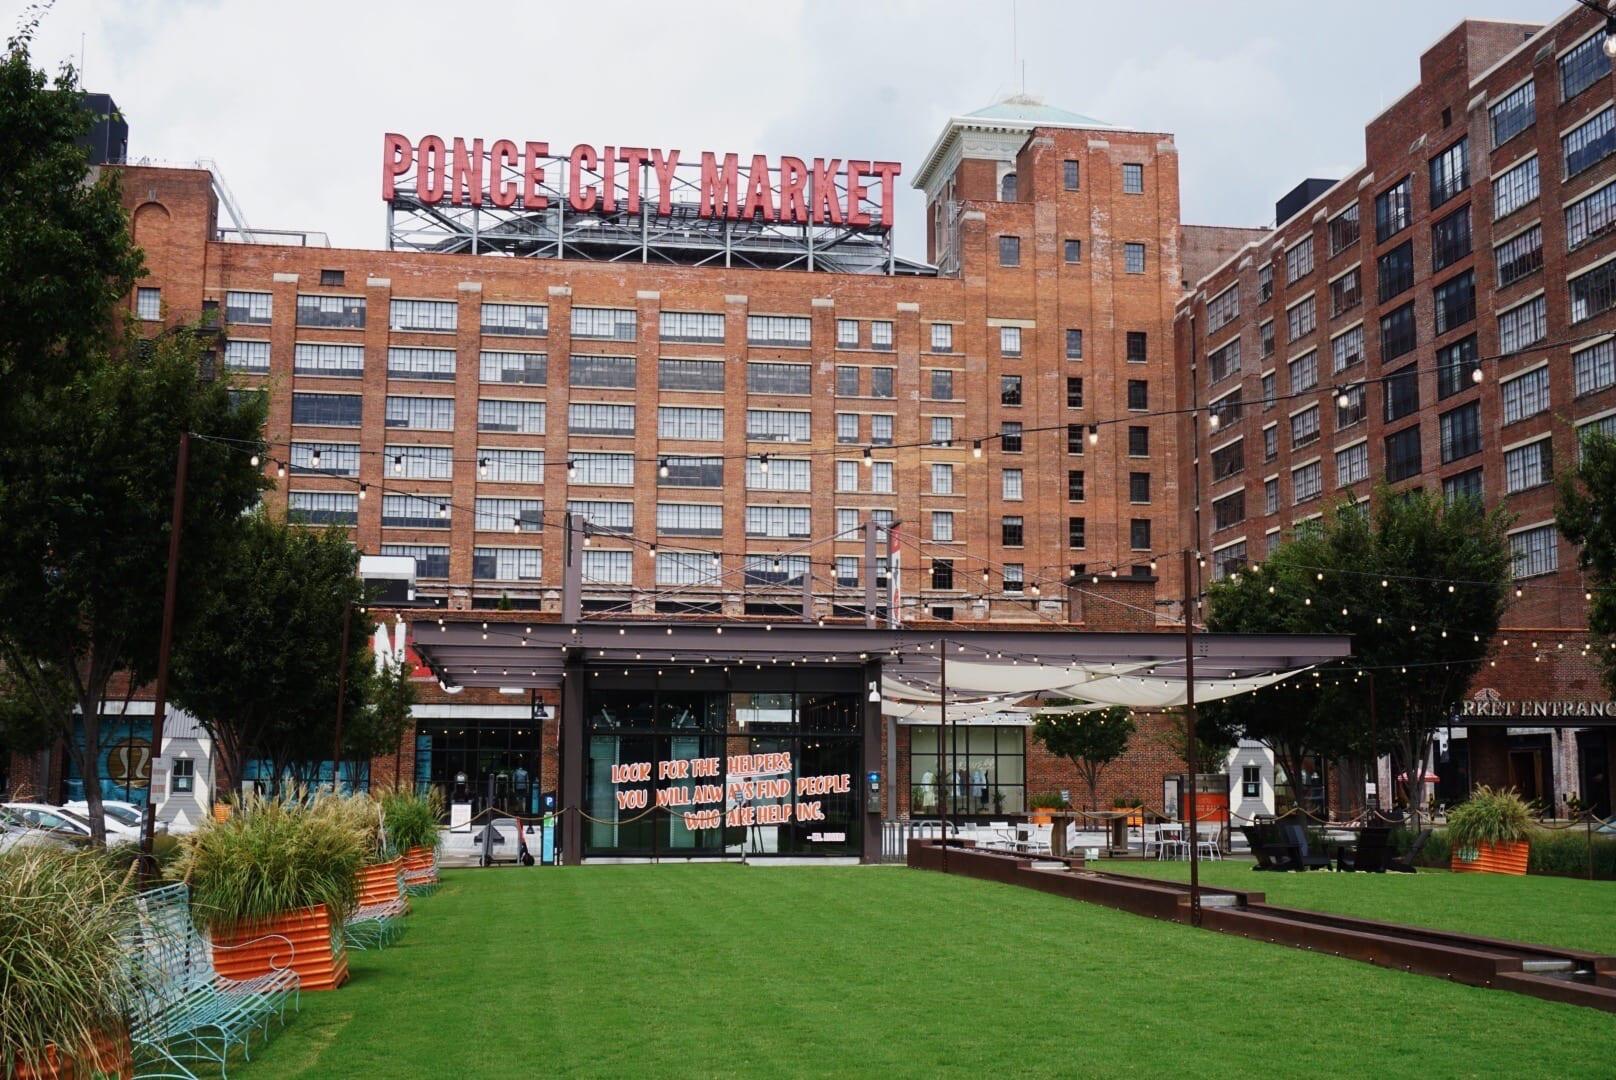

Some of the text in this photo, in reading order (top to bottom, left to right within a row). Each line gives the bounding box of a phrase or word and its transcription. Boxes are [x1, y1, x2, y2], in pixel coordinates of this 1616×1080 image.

[382, 132, 902, 229] PONCE CITY MARKET
[1451, 700, 1515, 717] RKET
[611, 762, 652, 784] LOOK
[658, 759, 689, 780] FOR
[690, 757, 720, 778] THE
[617, 789, 648, 810] YOU
[655, 786, 692, 807] WILL
[756, 778, 791, 799] FIND
[796, 773, 851, 796] PEOPLE
[684, 808, 721, 831] WHO
[726, 806, 755, 828] ARE
